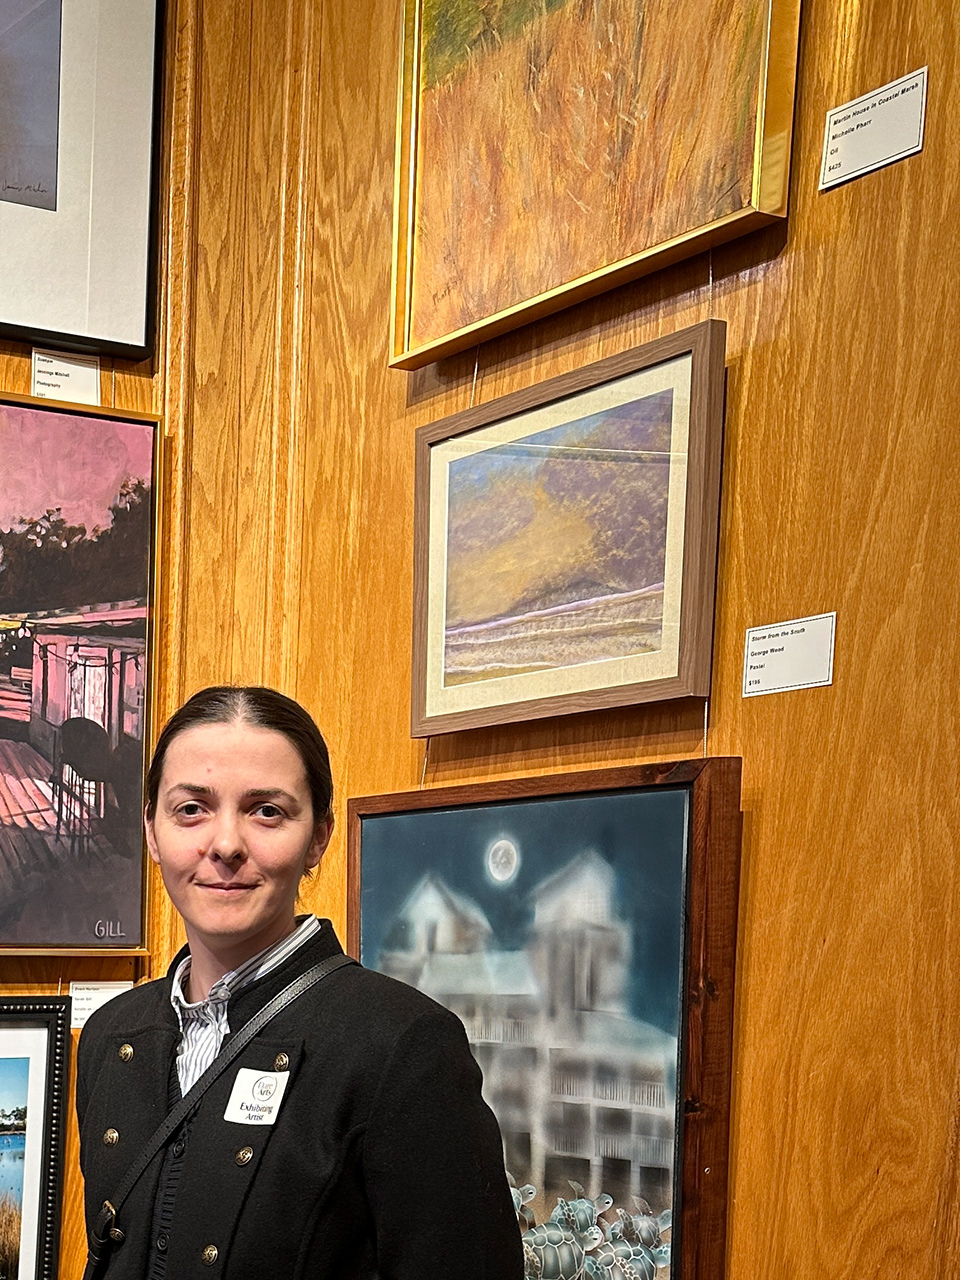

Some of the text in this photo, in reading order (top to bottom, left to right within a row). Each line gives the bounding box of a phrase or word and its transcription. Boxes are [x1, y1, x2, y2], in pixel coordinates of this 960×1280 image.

[833, 114, 851, 126] Martin
[852, 106, 870, 118] House
[878, 91, 900, 106] Coastal
[901, 82, 919, 95] Marsh
[831, 119, 872, 141] Michelle Pharr
[829, 147, 839, 156] Oil
[828, 161, 842, 172] $425
[36, 380, 61, 389] Photography
[790, 627, 806, 636] South
[750, 646, 785, 657] George Wood
[749, 663, 766, 671] Pastel
[95, 920, 126, 937] GILL
[240, 1102, 274, 1115] Exhibiting
[245, 1113, 265, 1121] Artist
